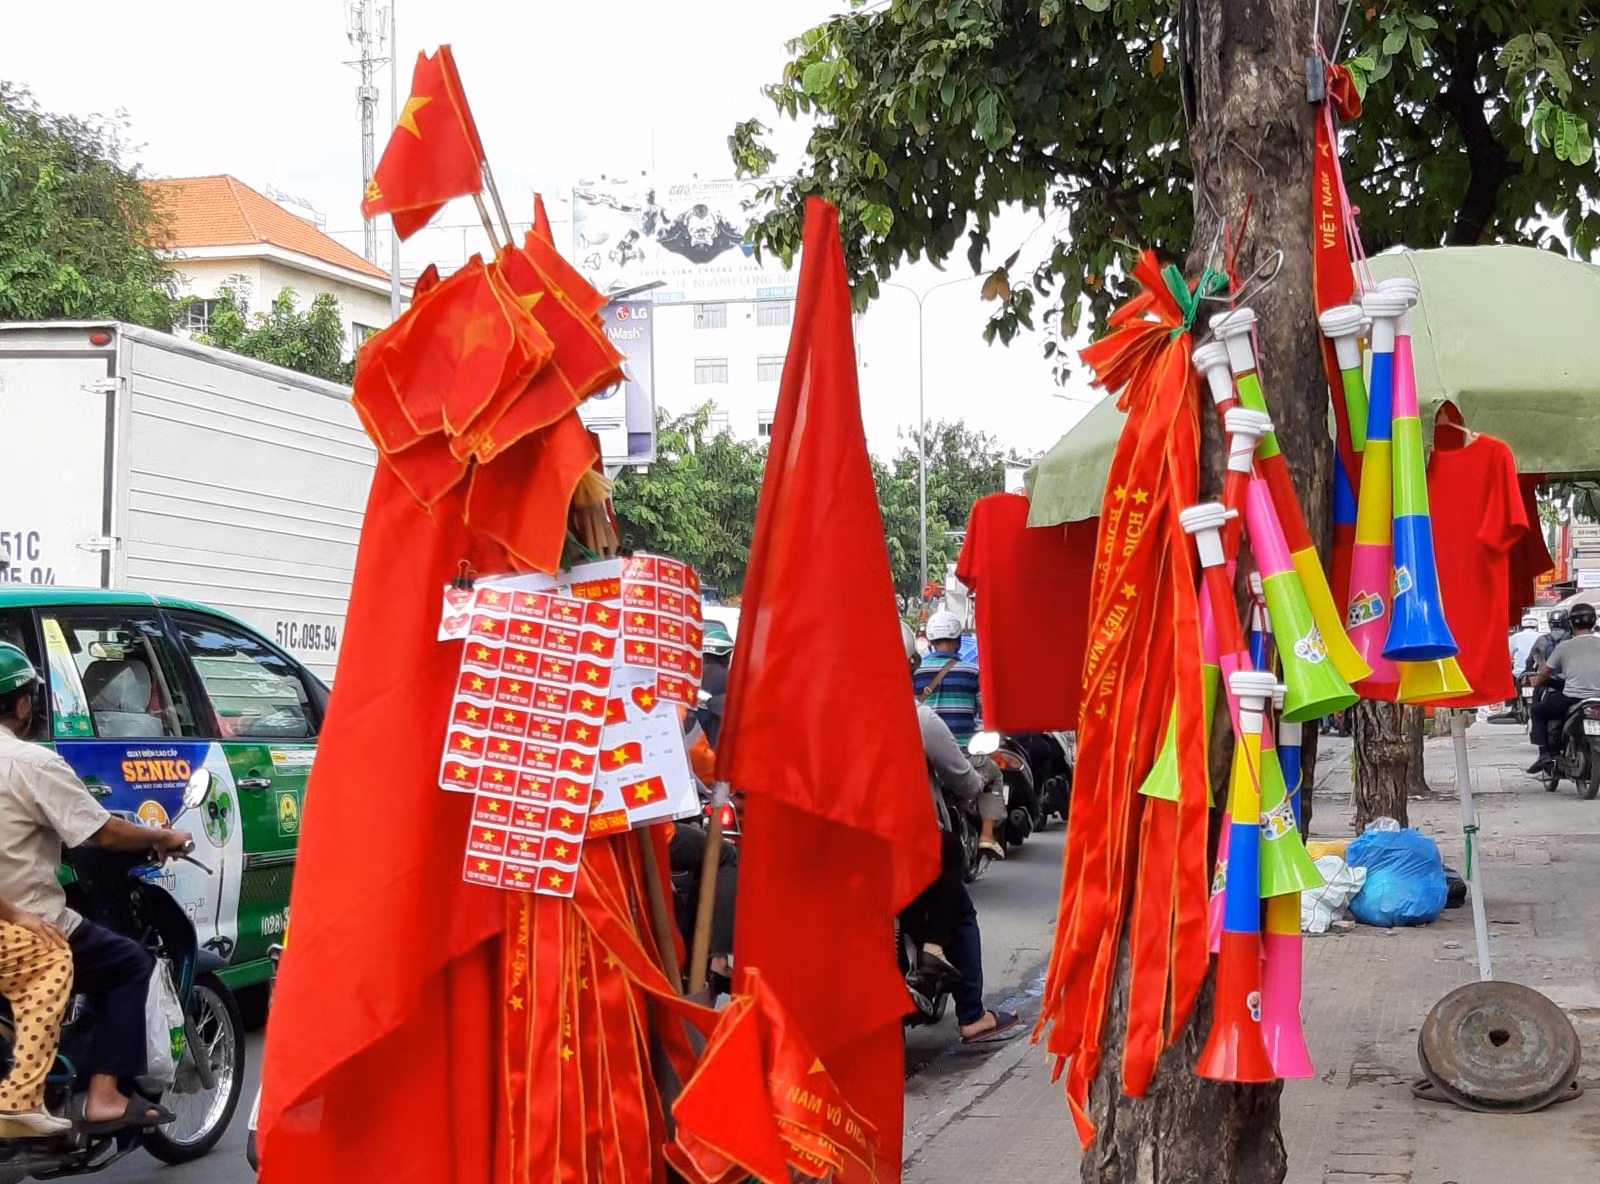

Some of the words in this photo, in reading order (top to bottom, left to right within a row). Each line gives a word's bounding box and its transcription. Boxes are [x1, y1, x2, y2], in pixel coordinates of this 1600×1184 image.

[1319, 210, 1336, 249] VIỆT
[631, 307, 648, 319] LG
[0, 531, 41, 561] 51C
[1101, 605, 1128, 641] VIỆT
[121, 759, 191, 782] SENKO
[787, 1085, 822, 1113] NAM
[827, 1103, 842, 1126] VÔ
